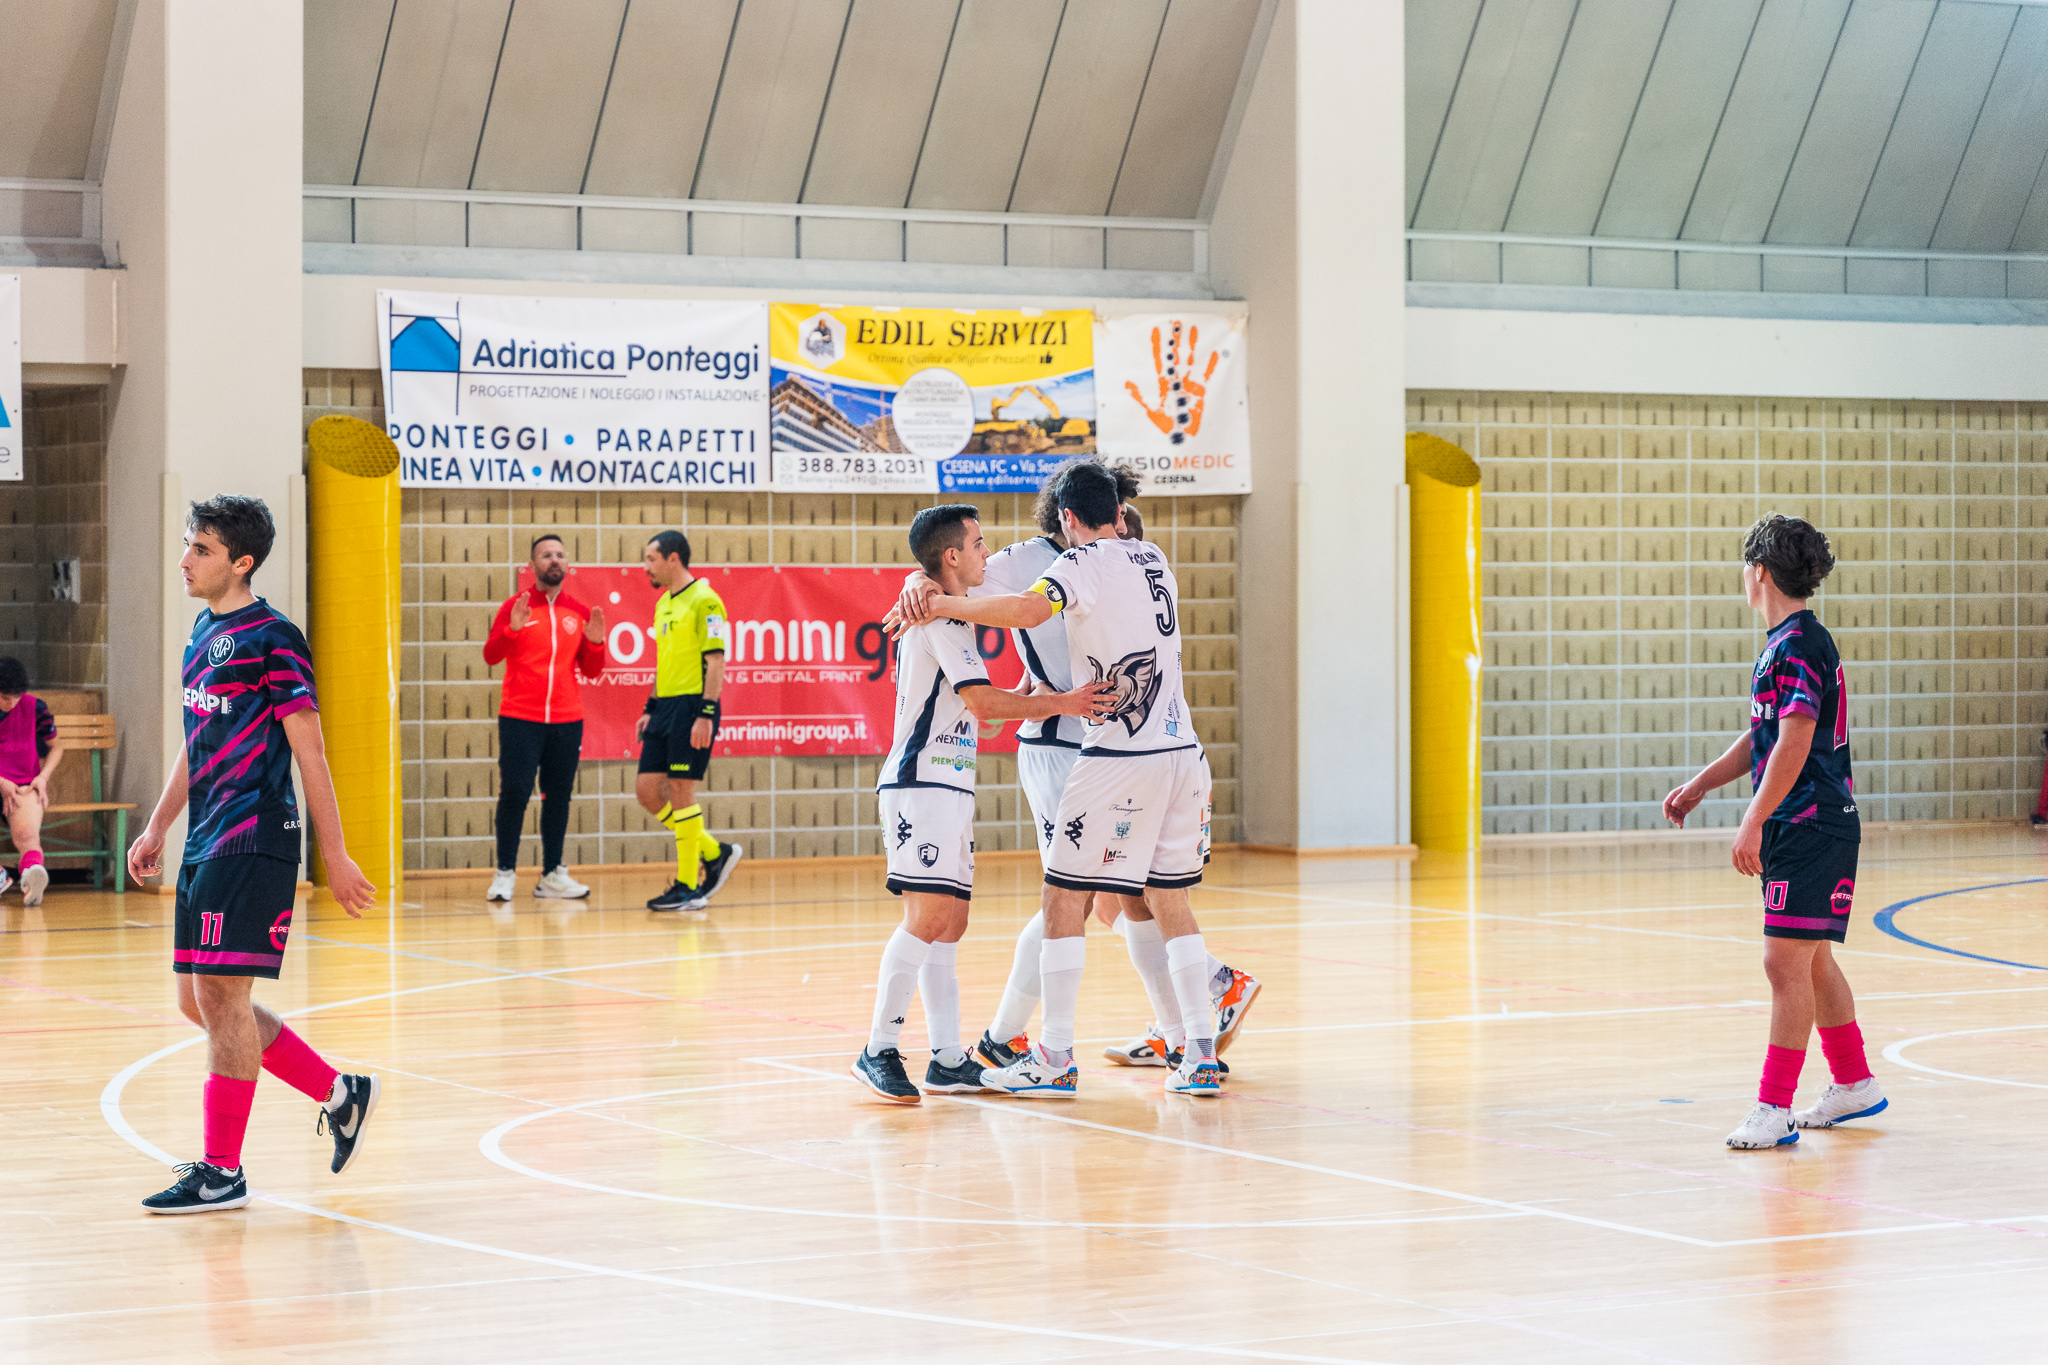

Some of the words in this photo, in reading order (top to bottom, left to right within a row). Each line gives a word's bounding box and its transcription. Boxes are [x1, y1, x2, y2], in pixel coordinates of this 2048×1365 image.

[856, 318, 935, 347] EDIL
[948, 320, 1068, 347] SERVIZI
[472, 338, 616, 371] Adriatica
[627, 343, 759, 380] Ponteggi
[469, 384, 579, 399] PROGETTAZIONE
[590, 386, 655, 400] NOLEGGIO
[665, 388, 761, 402] INSTALLAZIONE
[390, 423, 547, 451] PONTEGGI
[597, 428, 755, 452] PARAPETTI
[402, 457, 462, 481] INEA
[470, 458, 525, 482] VITA
[550, 460, 755, 484] MONTACARICHI
[799, 457, 926, 474] 388.783.2031
[941, 459, 989, 474] CESENA
[990, 459, 1008, 474] FC
[1145, 569, 1176, 637] 5
[753, 671, 816, 683] DIGITAL
[819, 671, 863, 683] PRINT
[714, 720, 868, 744] onriminigroup.it
[201, 911, 223, 947] 11
